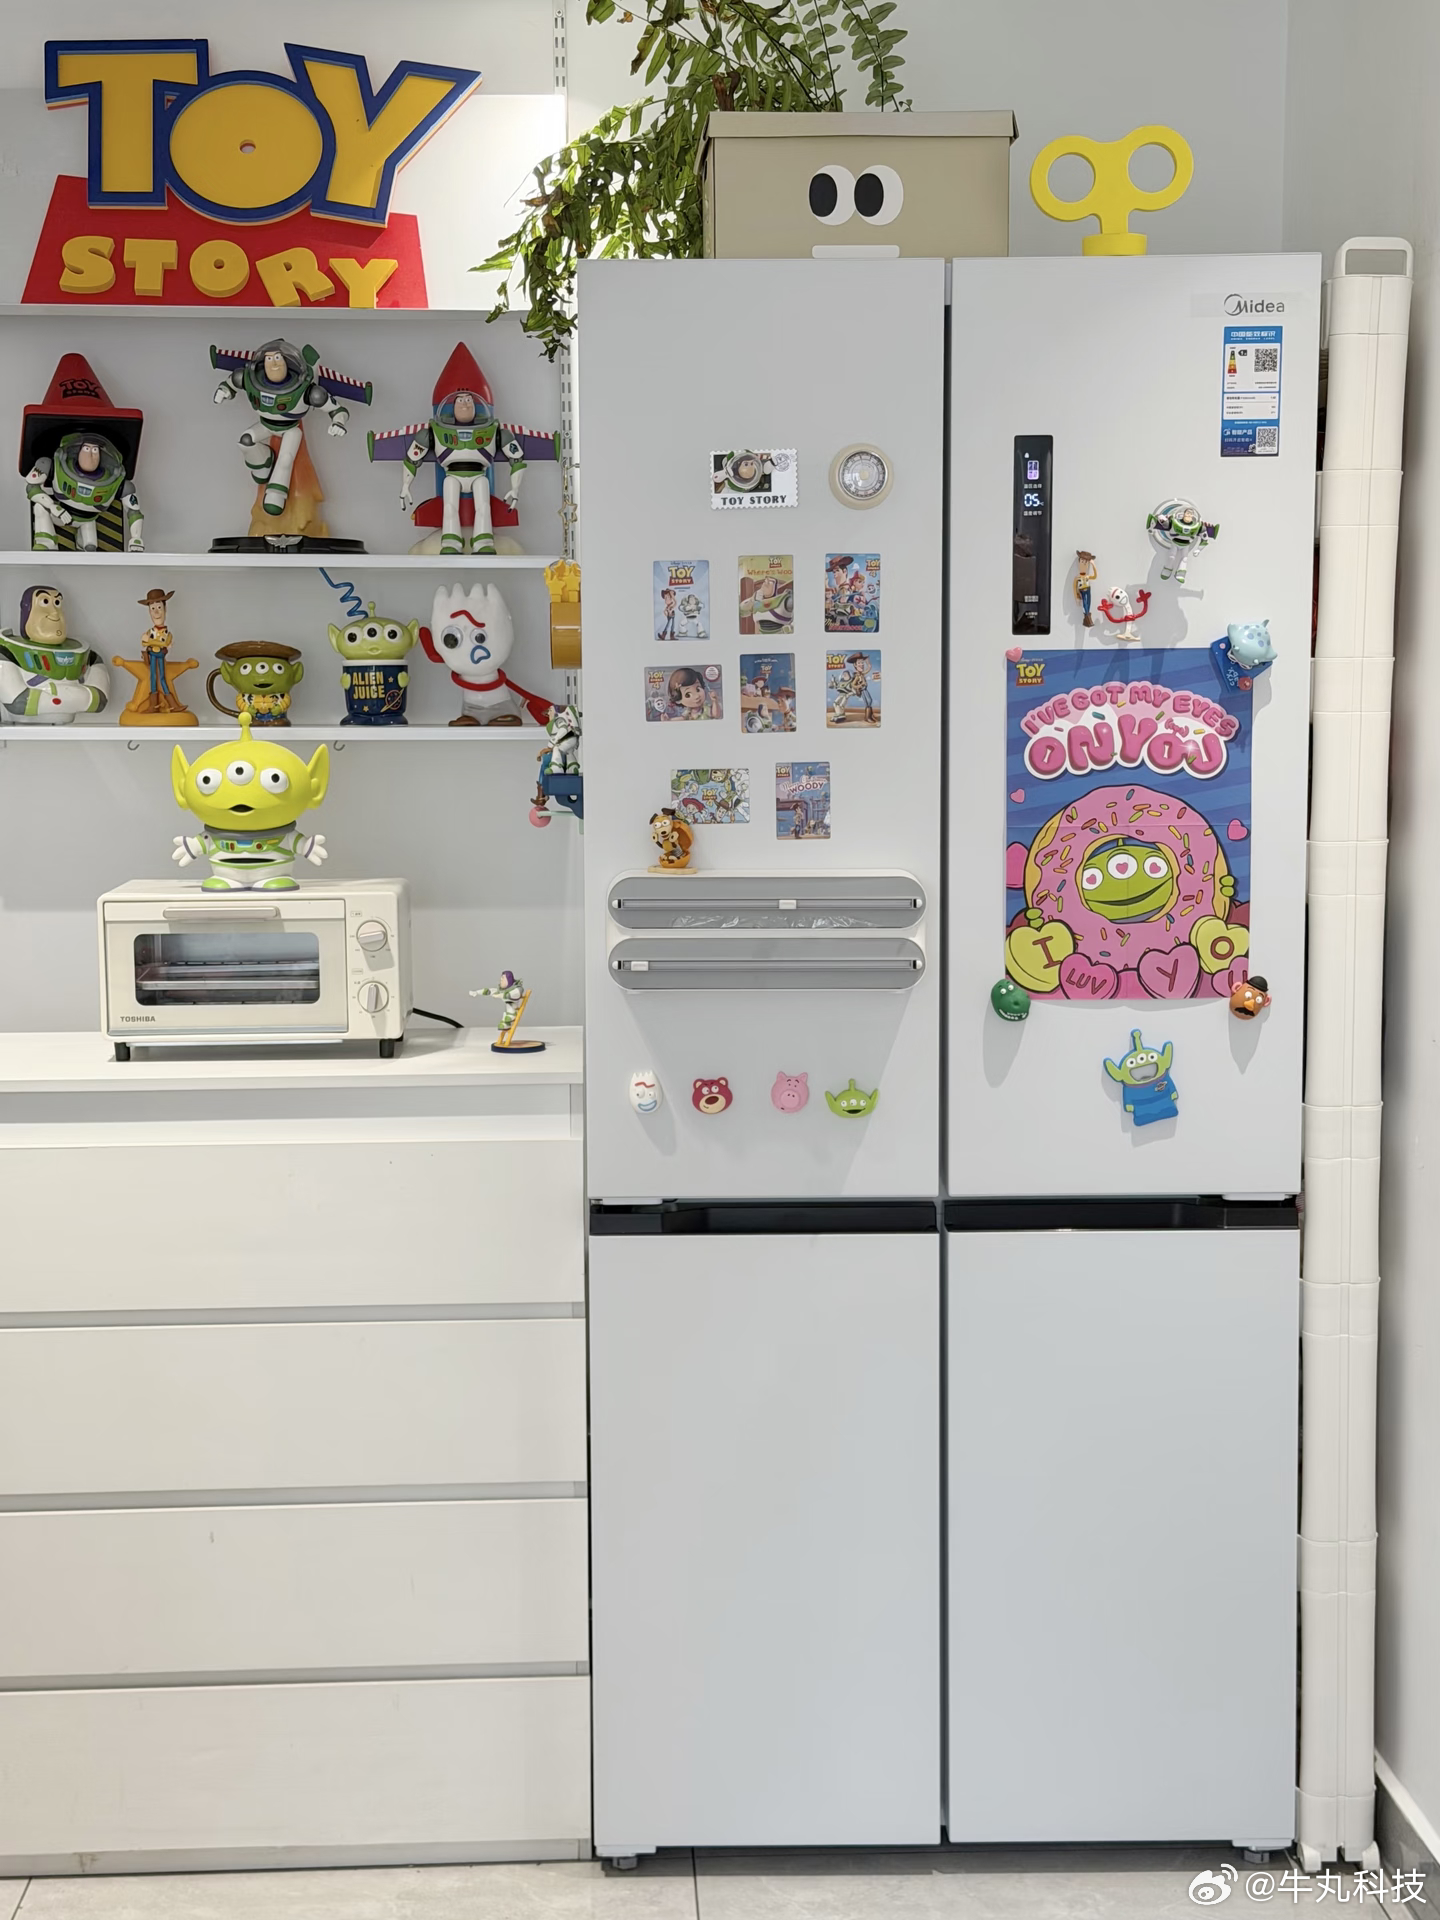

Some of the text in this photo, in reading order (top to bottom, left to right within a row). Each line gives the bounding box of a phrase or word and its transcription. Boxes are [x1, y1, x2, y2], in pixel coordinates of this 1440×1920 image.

[45, 39, 482, 228] TOY
[59, 236, 398, 308] STORY
[1224, 294, 1284, 316] Midea
[59, 378, 101, 391] TOY
[721, 495, 787, 505] TOY STORY
[668, 565, 696, 579] TOY
[826, 653, 847, 665] TOY
[647, 670, 665, 679] TOY
[1015, 662, 1046, 678] TOY
[352, 671, 384, 686] ALIEN
[353, 685, 386, 699] JUICE
[652, 682, 661, 690] 4
[1024, 684, 1237, 738] I'VE GOT MY EYES
[776, 766, 791, 774] TOY
[701, 788, 719, 798] TOY
[789, 782, 824, 794] WOODY
[1032, 936, 1063, 969] I
[1210, 936, 1235, 960] O
[1065, 968, 1107, 995] LUV
[1156, 959, 1179, 992] Y
[119, 1015, 156, 1023] TOSHIBA
